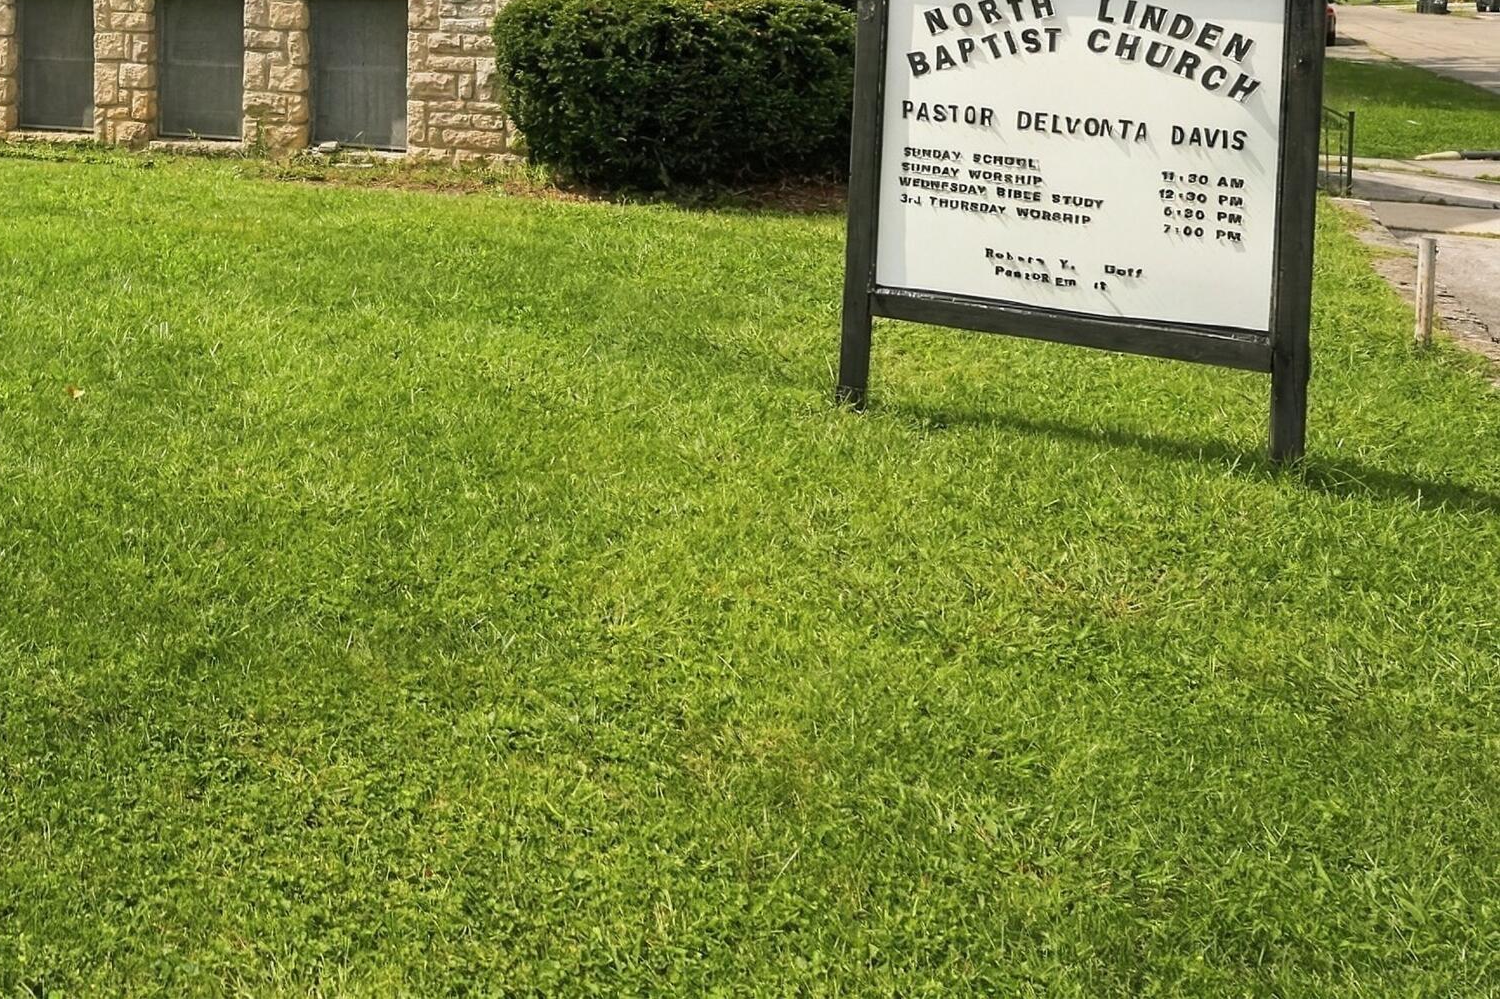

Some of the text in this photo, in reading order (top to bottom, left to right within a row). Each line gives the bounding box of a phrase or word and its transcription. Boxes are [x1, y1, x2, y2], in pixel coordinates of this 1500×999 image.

[906, 27, 1261, 103] BAPTIST CHURCH
[902, 100, 994, 127] PASTOR
[1171, 125, 1248, 151] DAVIS
[901, 162, 1243, 207] SUNDAY WORSHIP 12:30 PM
[903, 146, 1245, 189] SUNDAY SCHOOL 11:30 AM
[929, 196, 1007, 214] THURSDAY
[1016, 207, 1092, 225] WORSHIP
[1163, 223, 1204, 238] 7:00
[1216, 229, 1241, 242] PM
[1051, 194, 1104, 209] STUDY
[1217, 211, 1242, 224] PM
